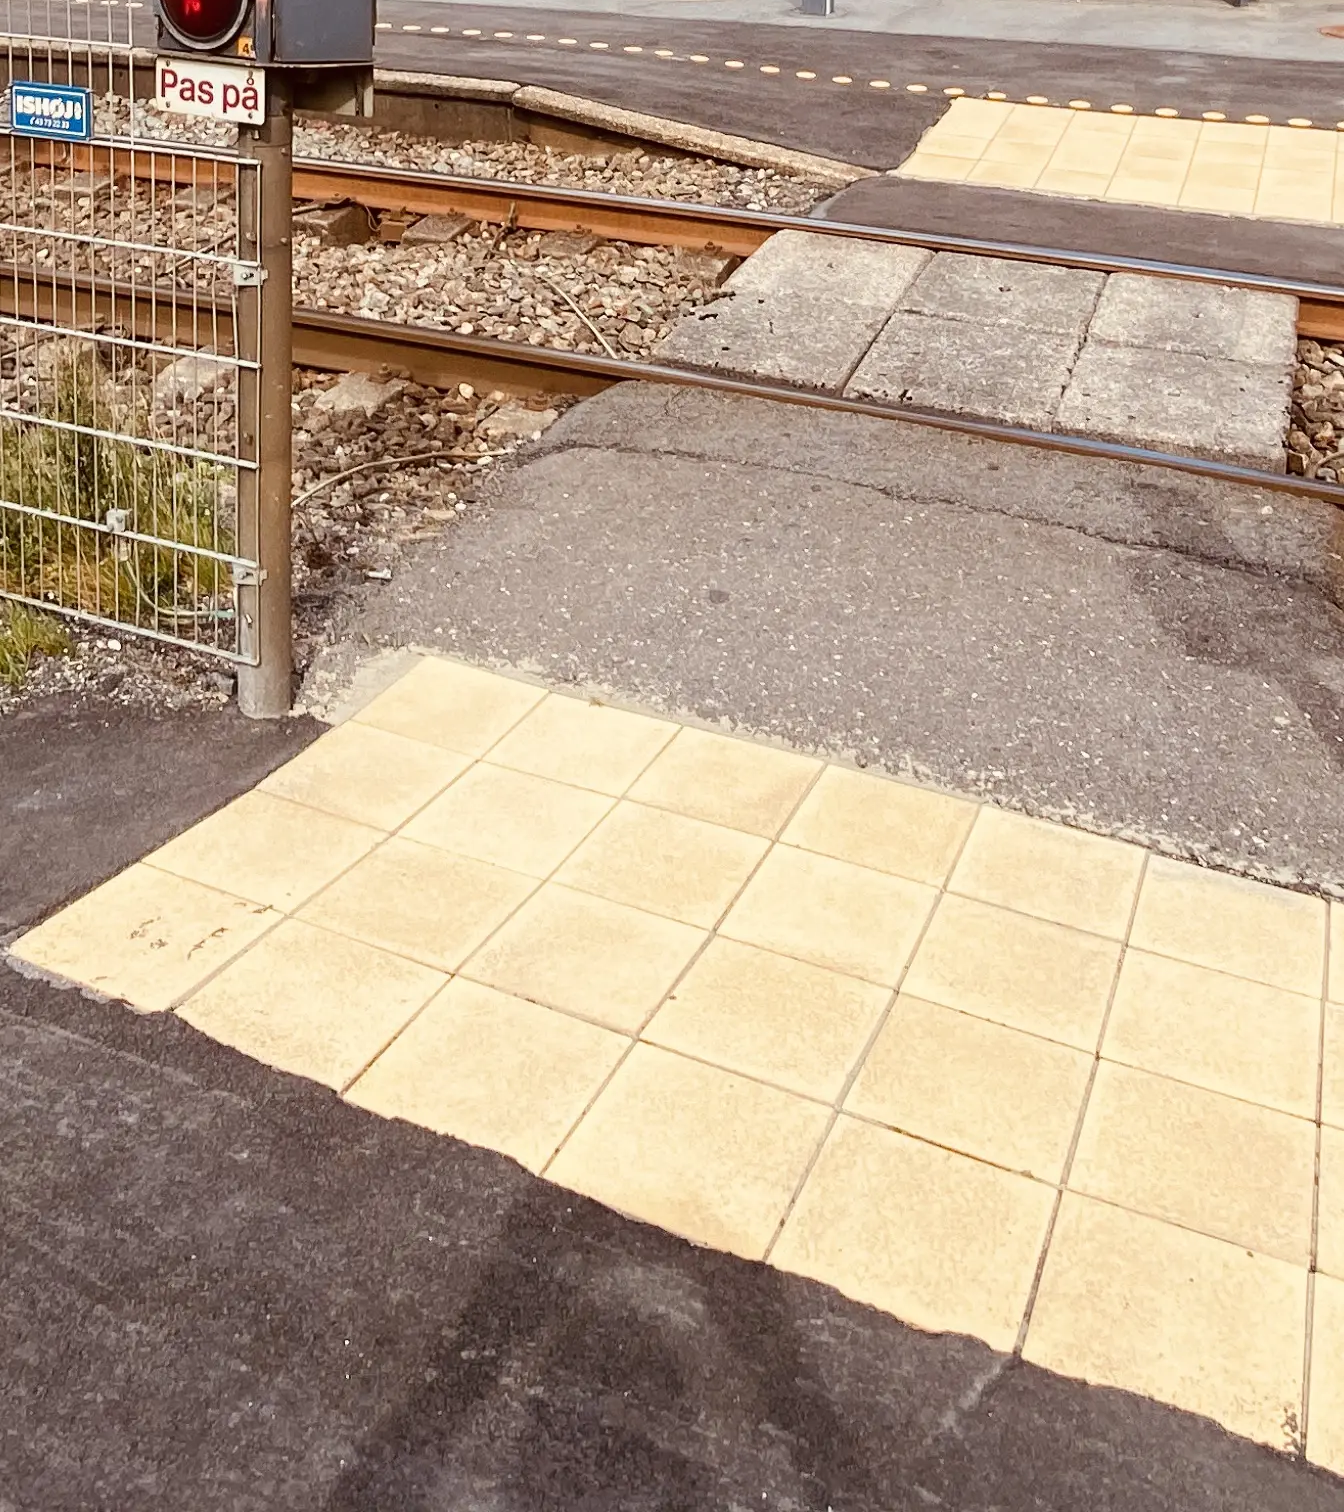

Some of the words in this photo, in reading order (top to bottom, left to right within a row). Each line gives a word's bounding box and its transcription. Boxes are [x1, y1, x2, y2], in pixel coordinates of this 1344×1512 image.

[242, 43, 250, 54] 4
[160, 68, 214, 104] Pas
[222, 77, 259, 114] på
[16, 94, 74, 120] ISHØJ
